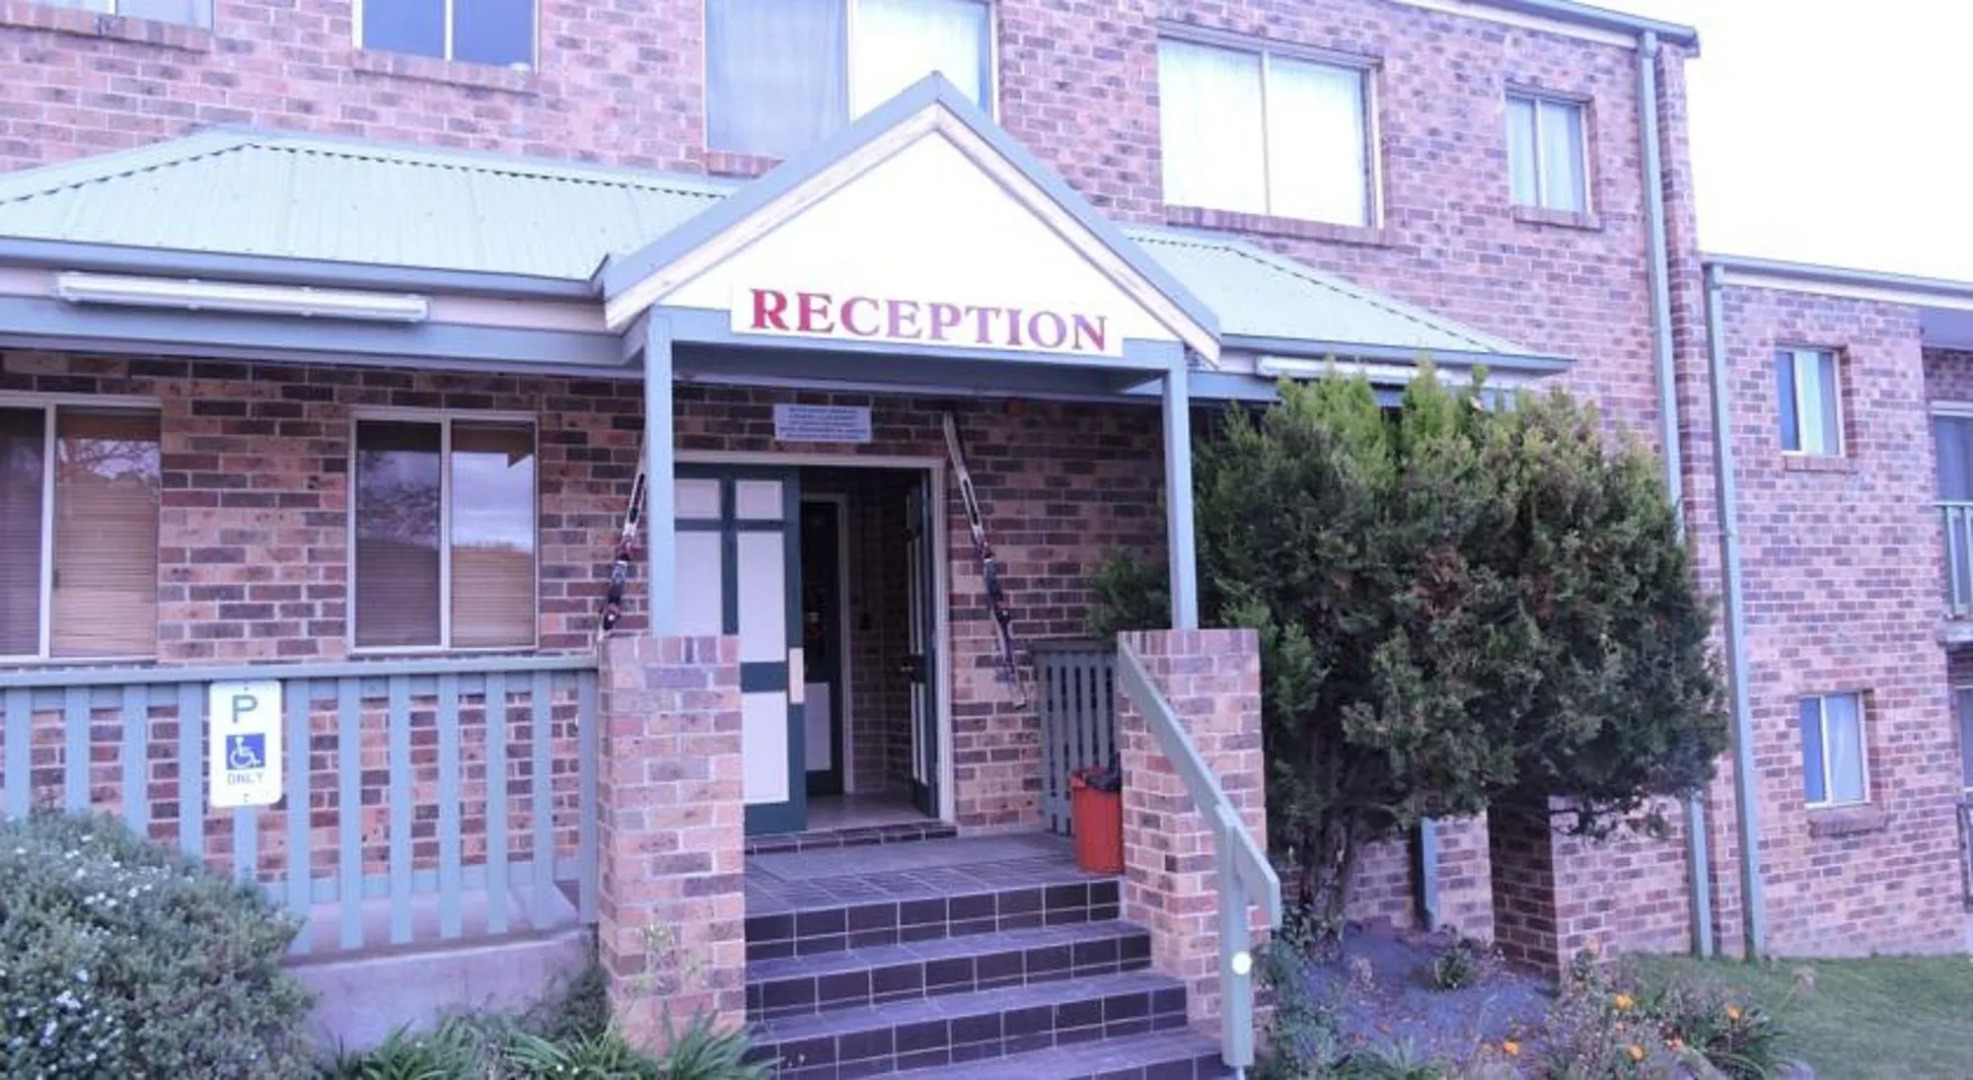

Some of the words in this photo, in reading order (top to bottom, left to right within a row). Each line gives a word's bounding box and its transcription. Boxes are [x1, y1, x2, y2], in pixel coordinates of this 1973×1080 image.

[749, 288, 1108, 351] RECEPTION
[232, 694, 259, 724] P
[227, 772, 264, 785] ONLY
